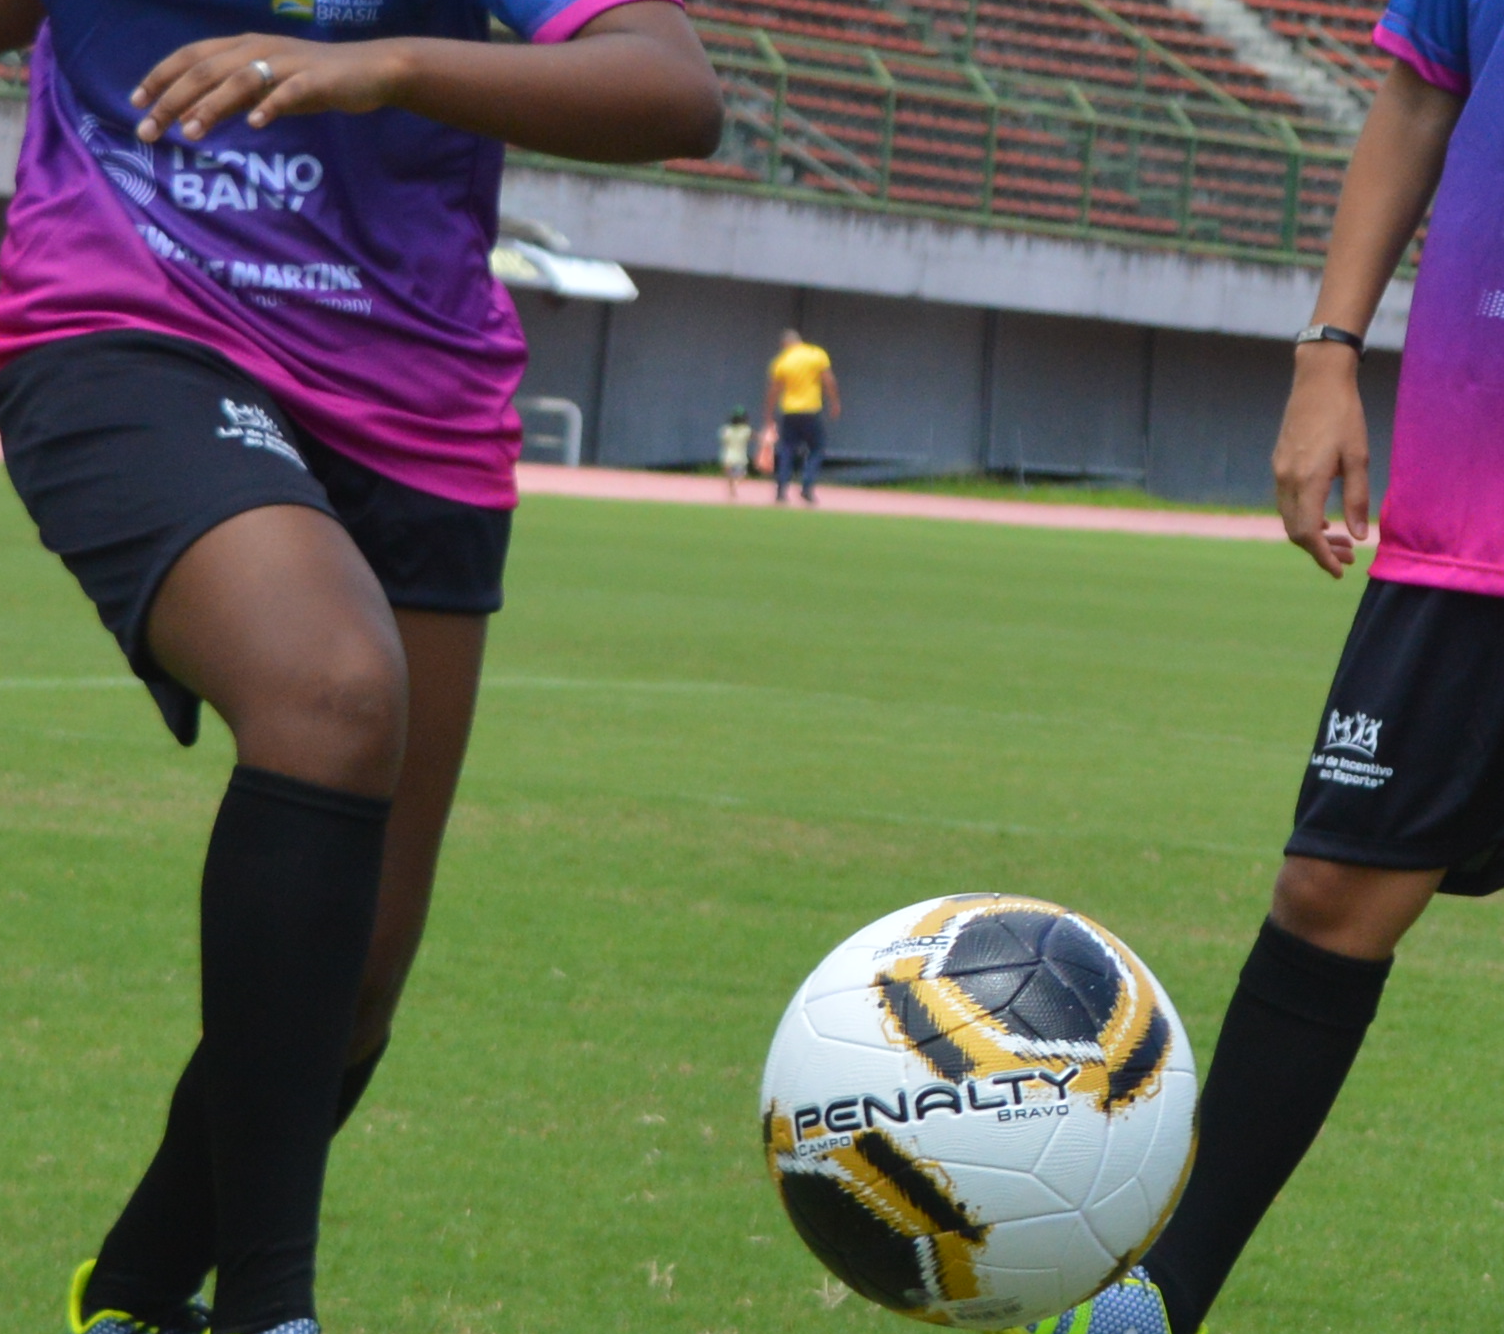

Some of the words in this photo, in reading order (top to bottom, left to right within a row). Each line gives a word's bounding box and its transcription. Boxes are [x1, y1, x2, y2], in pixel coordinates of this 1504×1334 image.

[316, 4, 380, 22] BRASIL
[231, 260, 363, 291] MARTINS
[1339, 757, 1393, 778] Incentivo
[794, 1068, 1080, 1142] PENALTY
